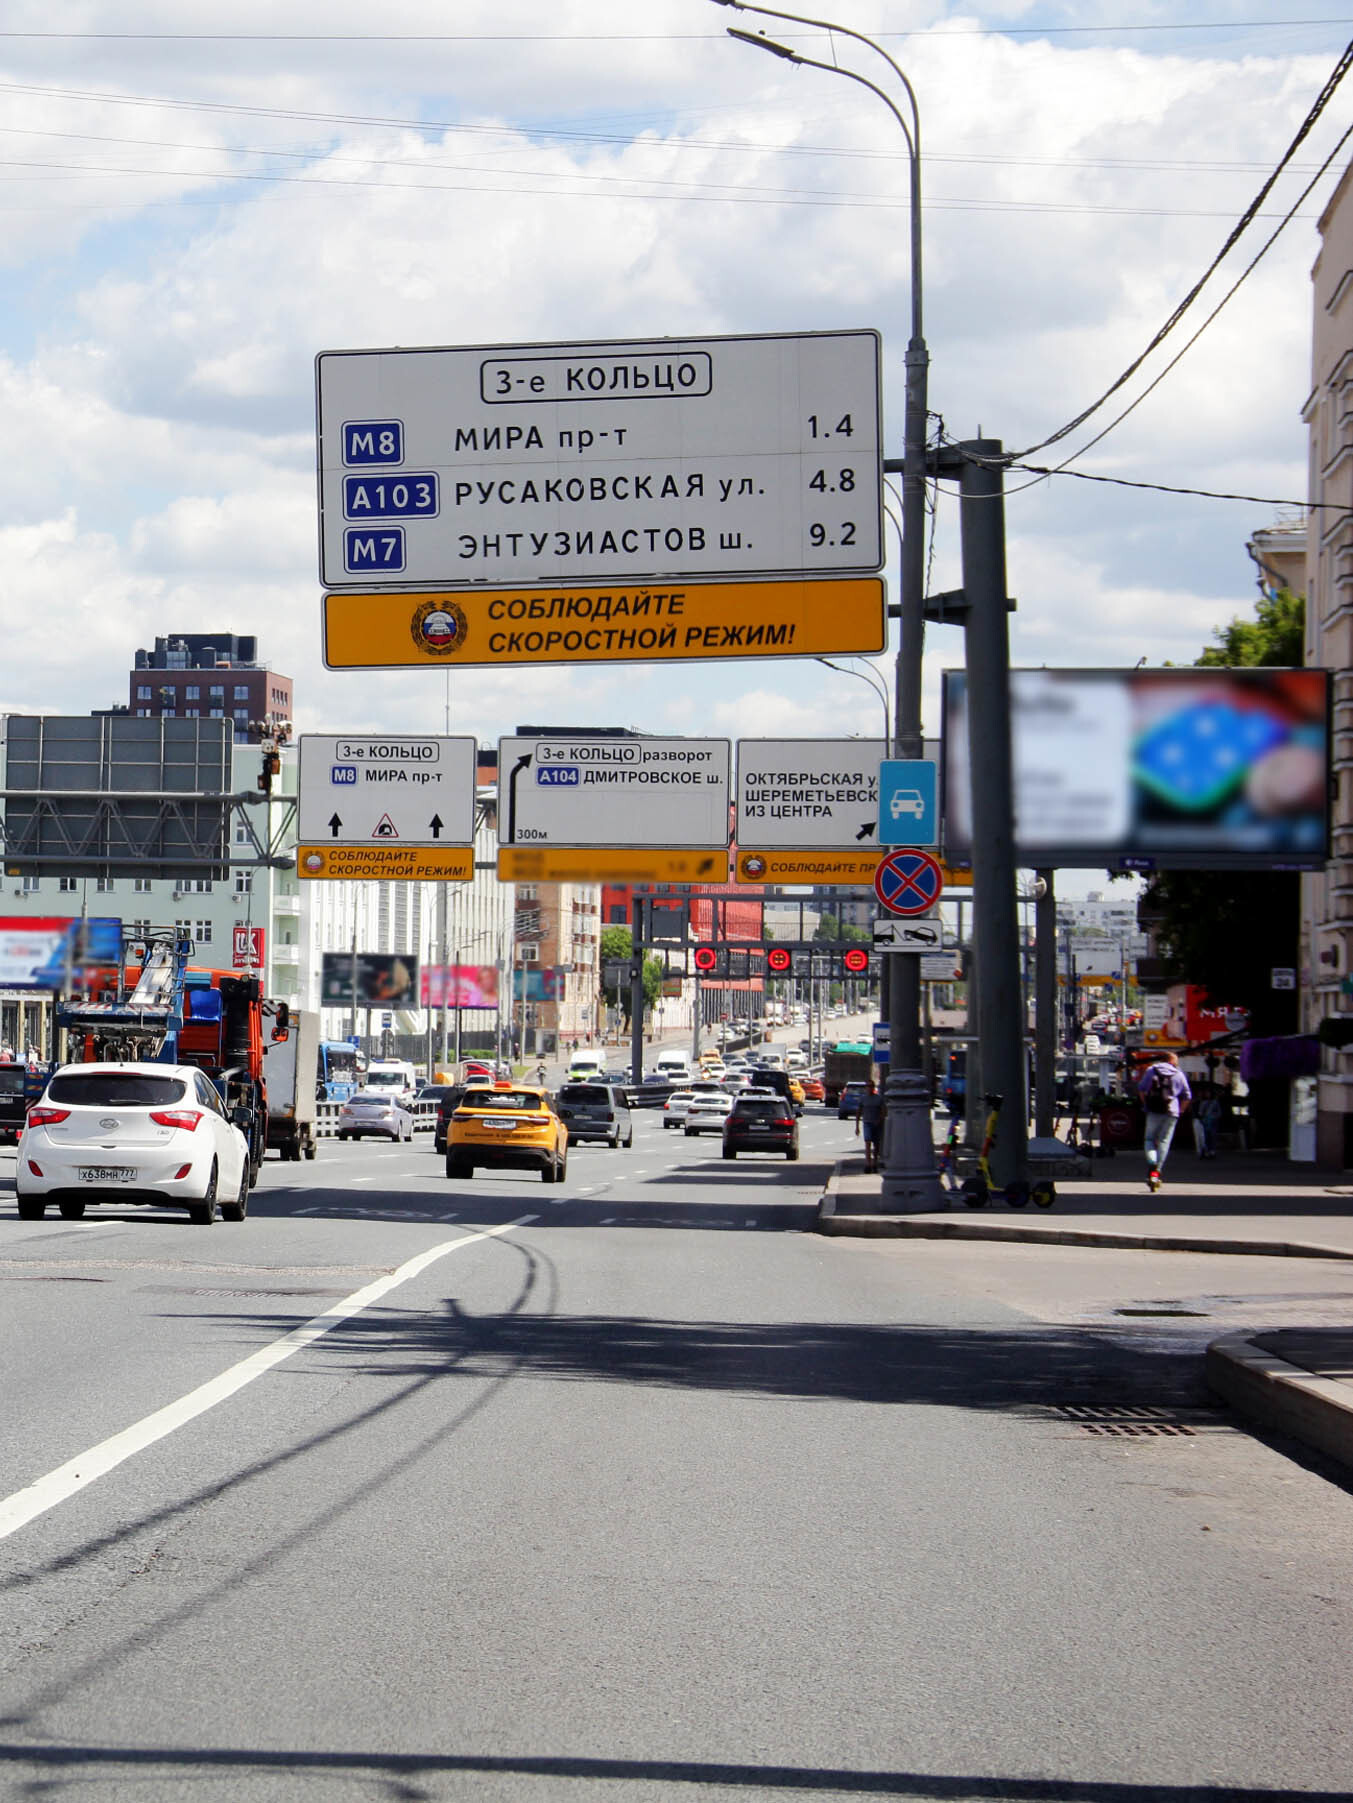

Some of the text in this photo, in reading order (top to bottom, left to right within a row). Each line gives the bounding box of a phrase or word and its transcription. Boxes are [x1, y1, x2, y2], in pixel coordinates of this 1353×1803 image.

[496, 362, 697, 395] 3-е КОЛЬЦО
[351, 413, 854, 456] М8 МИРА пр-т 1.4
[351, 468, 856, 510] А103 РУСАКОВСКАЯ ул. 4.8
[353, 521, 856, 562] М7 ЭНТУЗИАСТОВ ш. 9.2
[487, 591, 685, 622] СОБЛЮДАЙТЕ
[488, 623, 796, 653] СКОРОСТНОЙ РЕЖИМ!
[343, 745, 433, 761] 3-е КОЛЬЦО
[543, 747, 713, 763] 3-е КОЛЬЦО разворот
[334, 769, 443, 785] М8 МИРА пр-т
[539, 769, 723, 785] А104 ДМИТРОВСКОЕ ш.
[745, 772, 863, 786] ОКТЯБРЬСКАЯ
[745, 789, 878, 803] ШЕРЕМЕТЬЕВСК
[745, 804, 833, 820] ИЗ ЦЕНТРА
[517, 828, 548, 840] 300м
[328, 849, 418, 863] СОБЛЮДАЙТЕ
[328, 864, 467, 877] СКОРОСТНОЙ РЕЖИМ!
[770, 861, 856, 875] СОБЛЮДАЙТЕ
